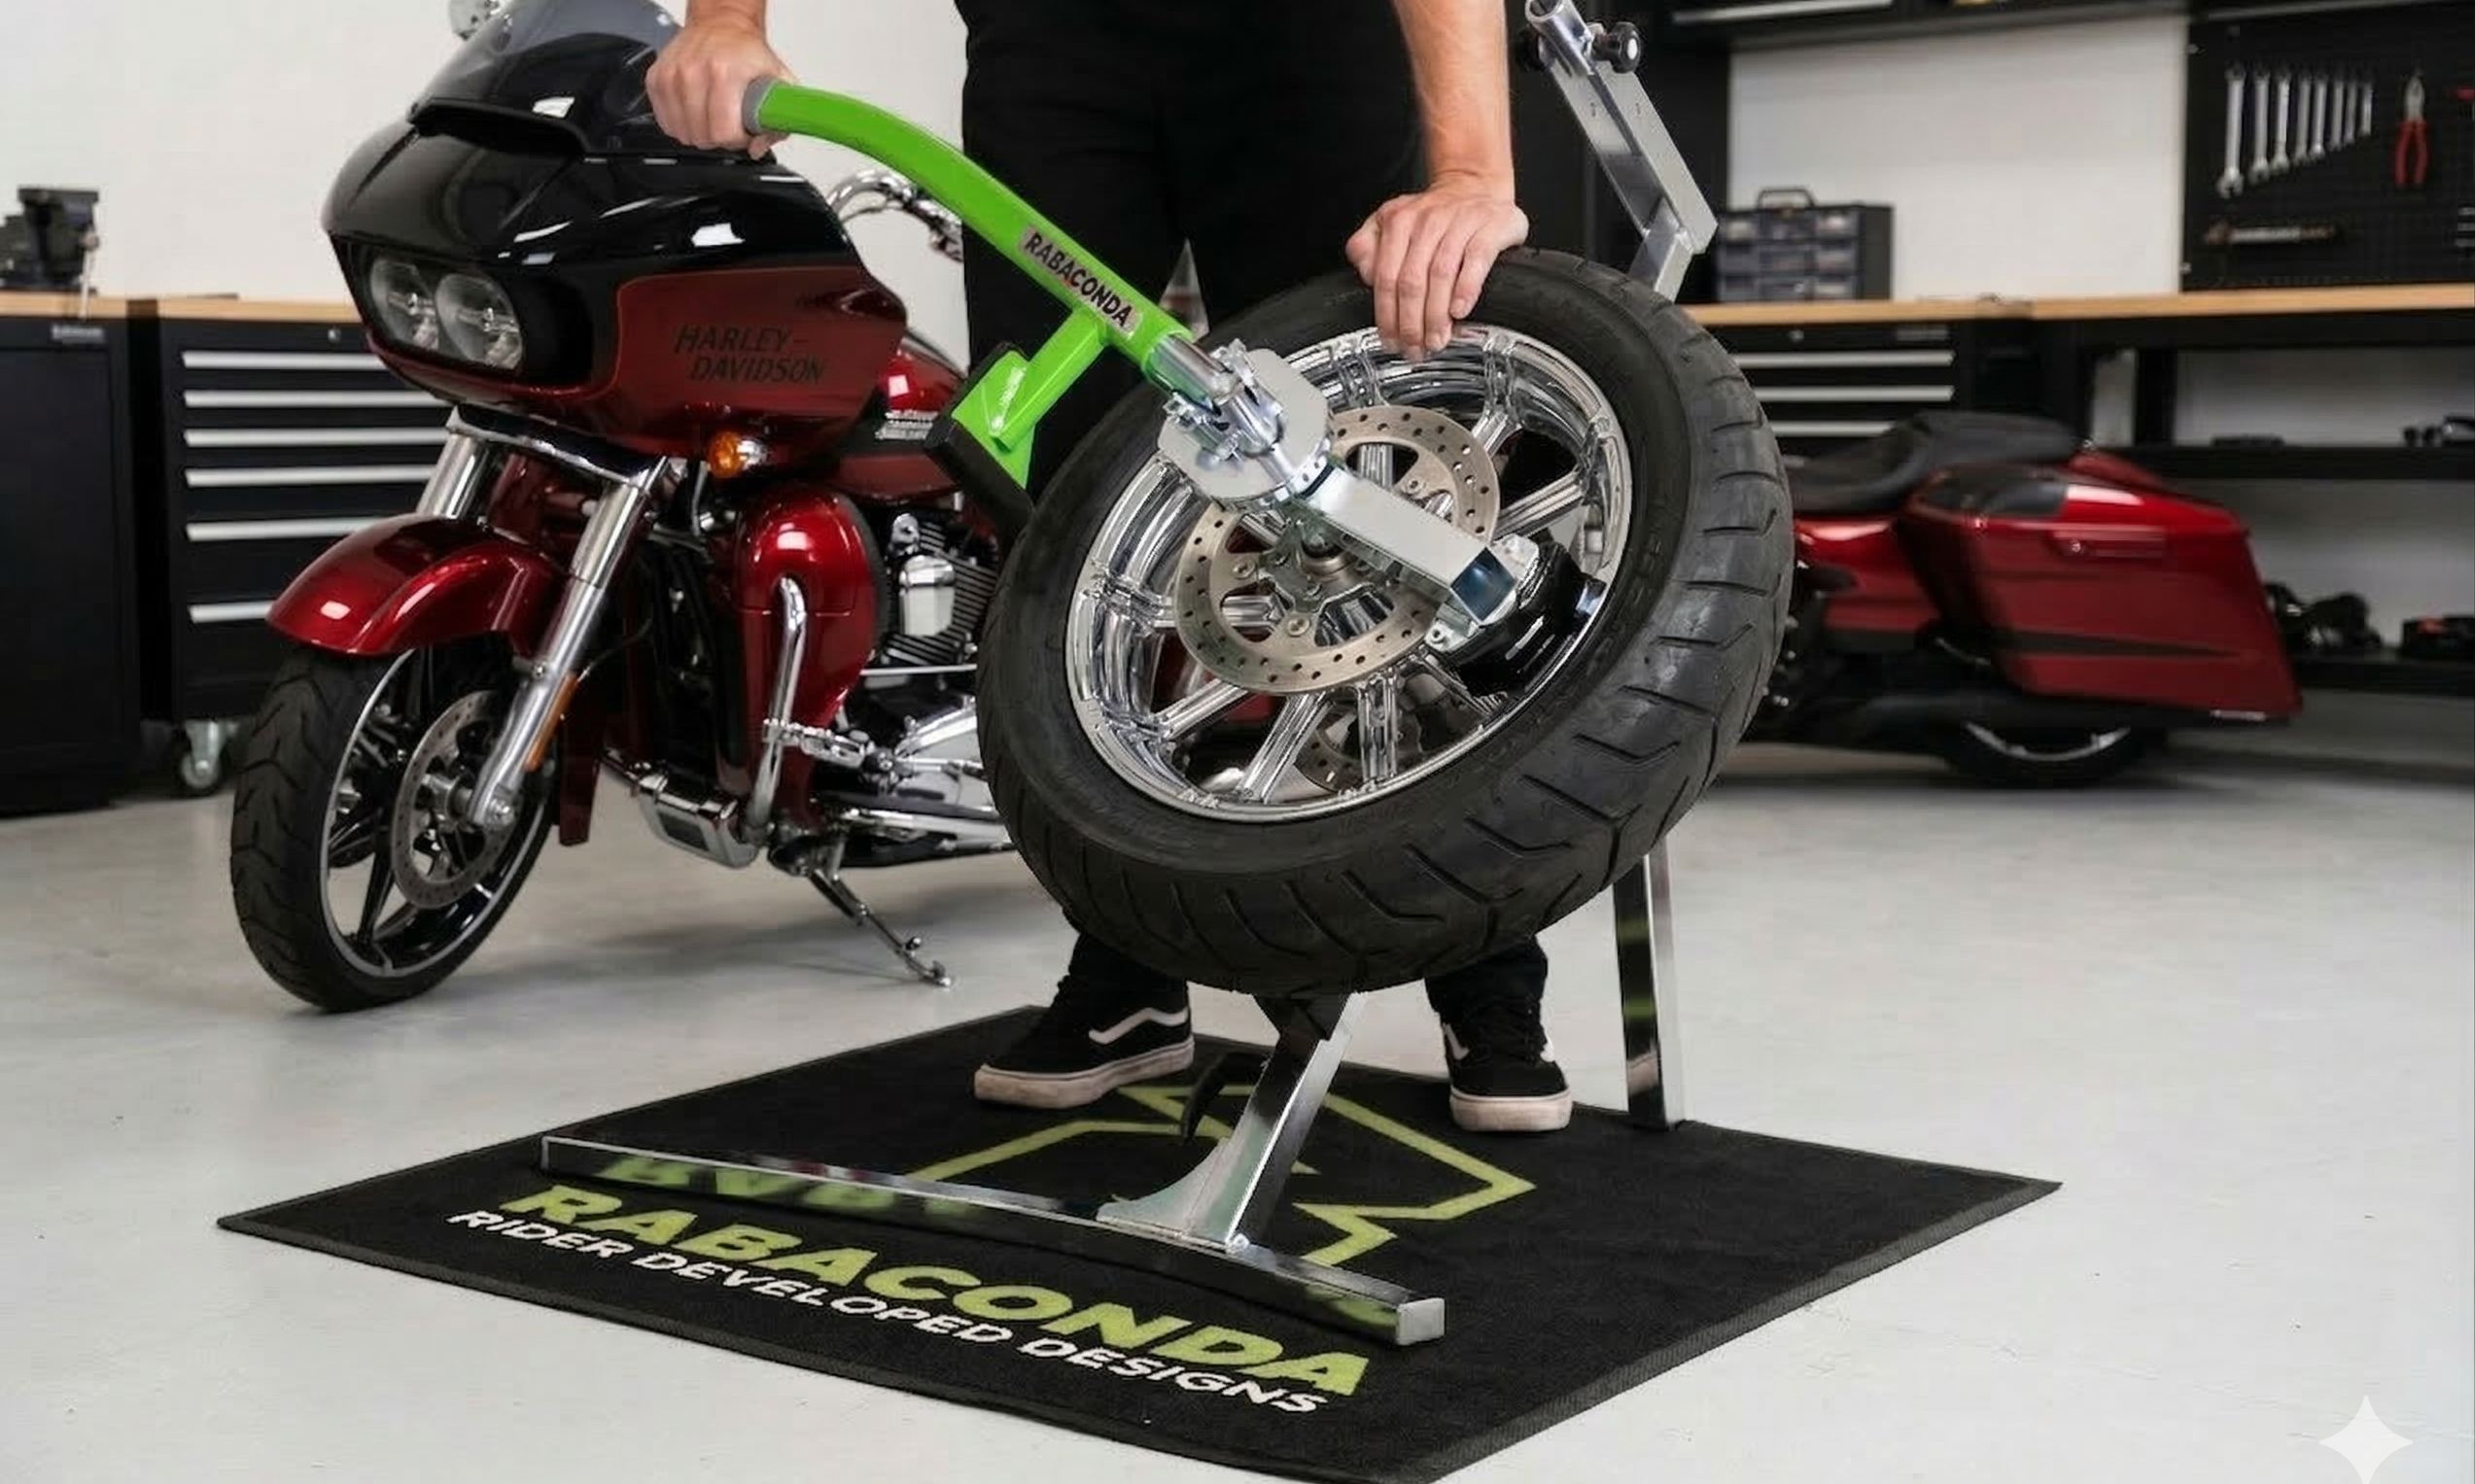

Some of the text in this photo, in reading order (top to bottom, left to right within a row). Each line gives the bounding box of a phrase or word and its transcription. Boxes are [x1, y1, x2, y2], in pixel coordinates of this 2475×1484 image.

[1024, 232, 1133, 328] RABACONDA
[687, 356, 824, 383] DAVIDSON
[446, 1211, 1328, 1413] RIDER DEVELOPED DESIGNS
[500, 1185, 1369, 1396] RABACONDA
